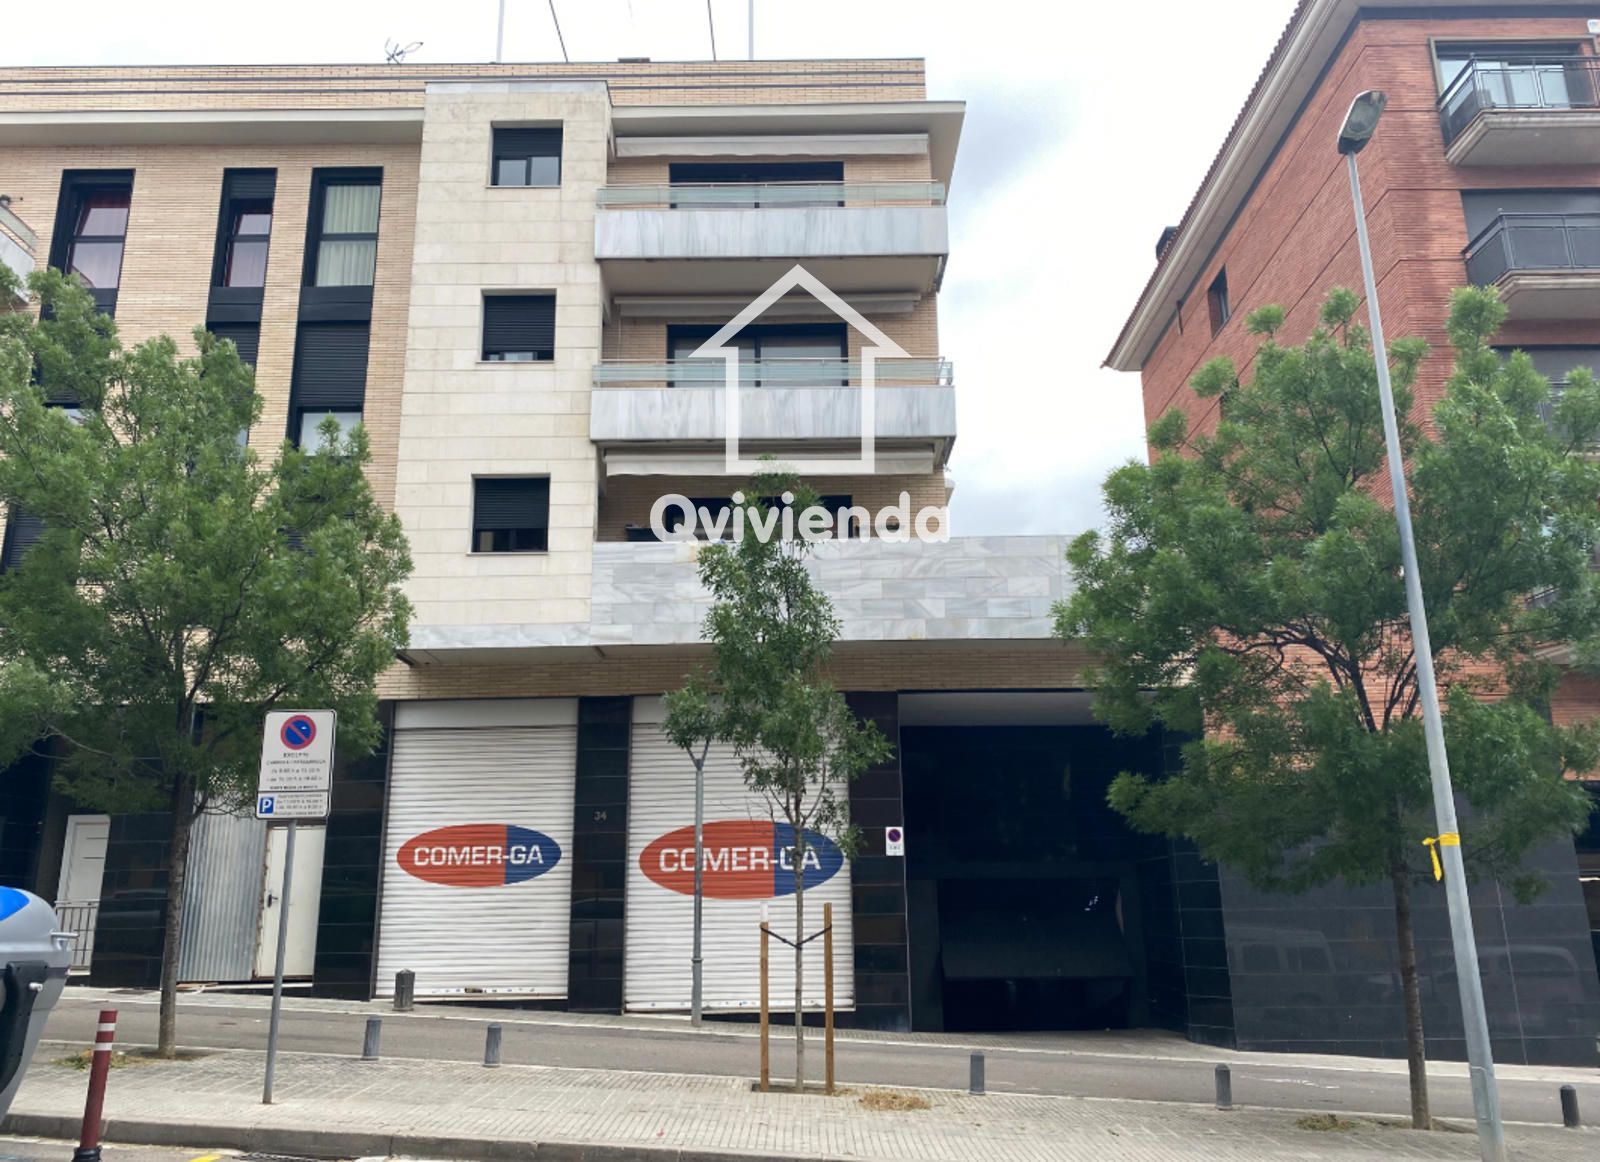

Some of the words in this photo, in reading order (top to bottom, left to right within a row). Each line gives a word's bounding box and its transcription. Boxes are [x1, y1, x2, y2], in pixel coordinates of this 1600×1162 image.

[262, 798, 272, 813] P
[594, 810, 607, 821] 34
[413, 844, 544, 867] COMER-GA
